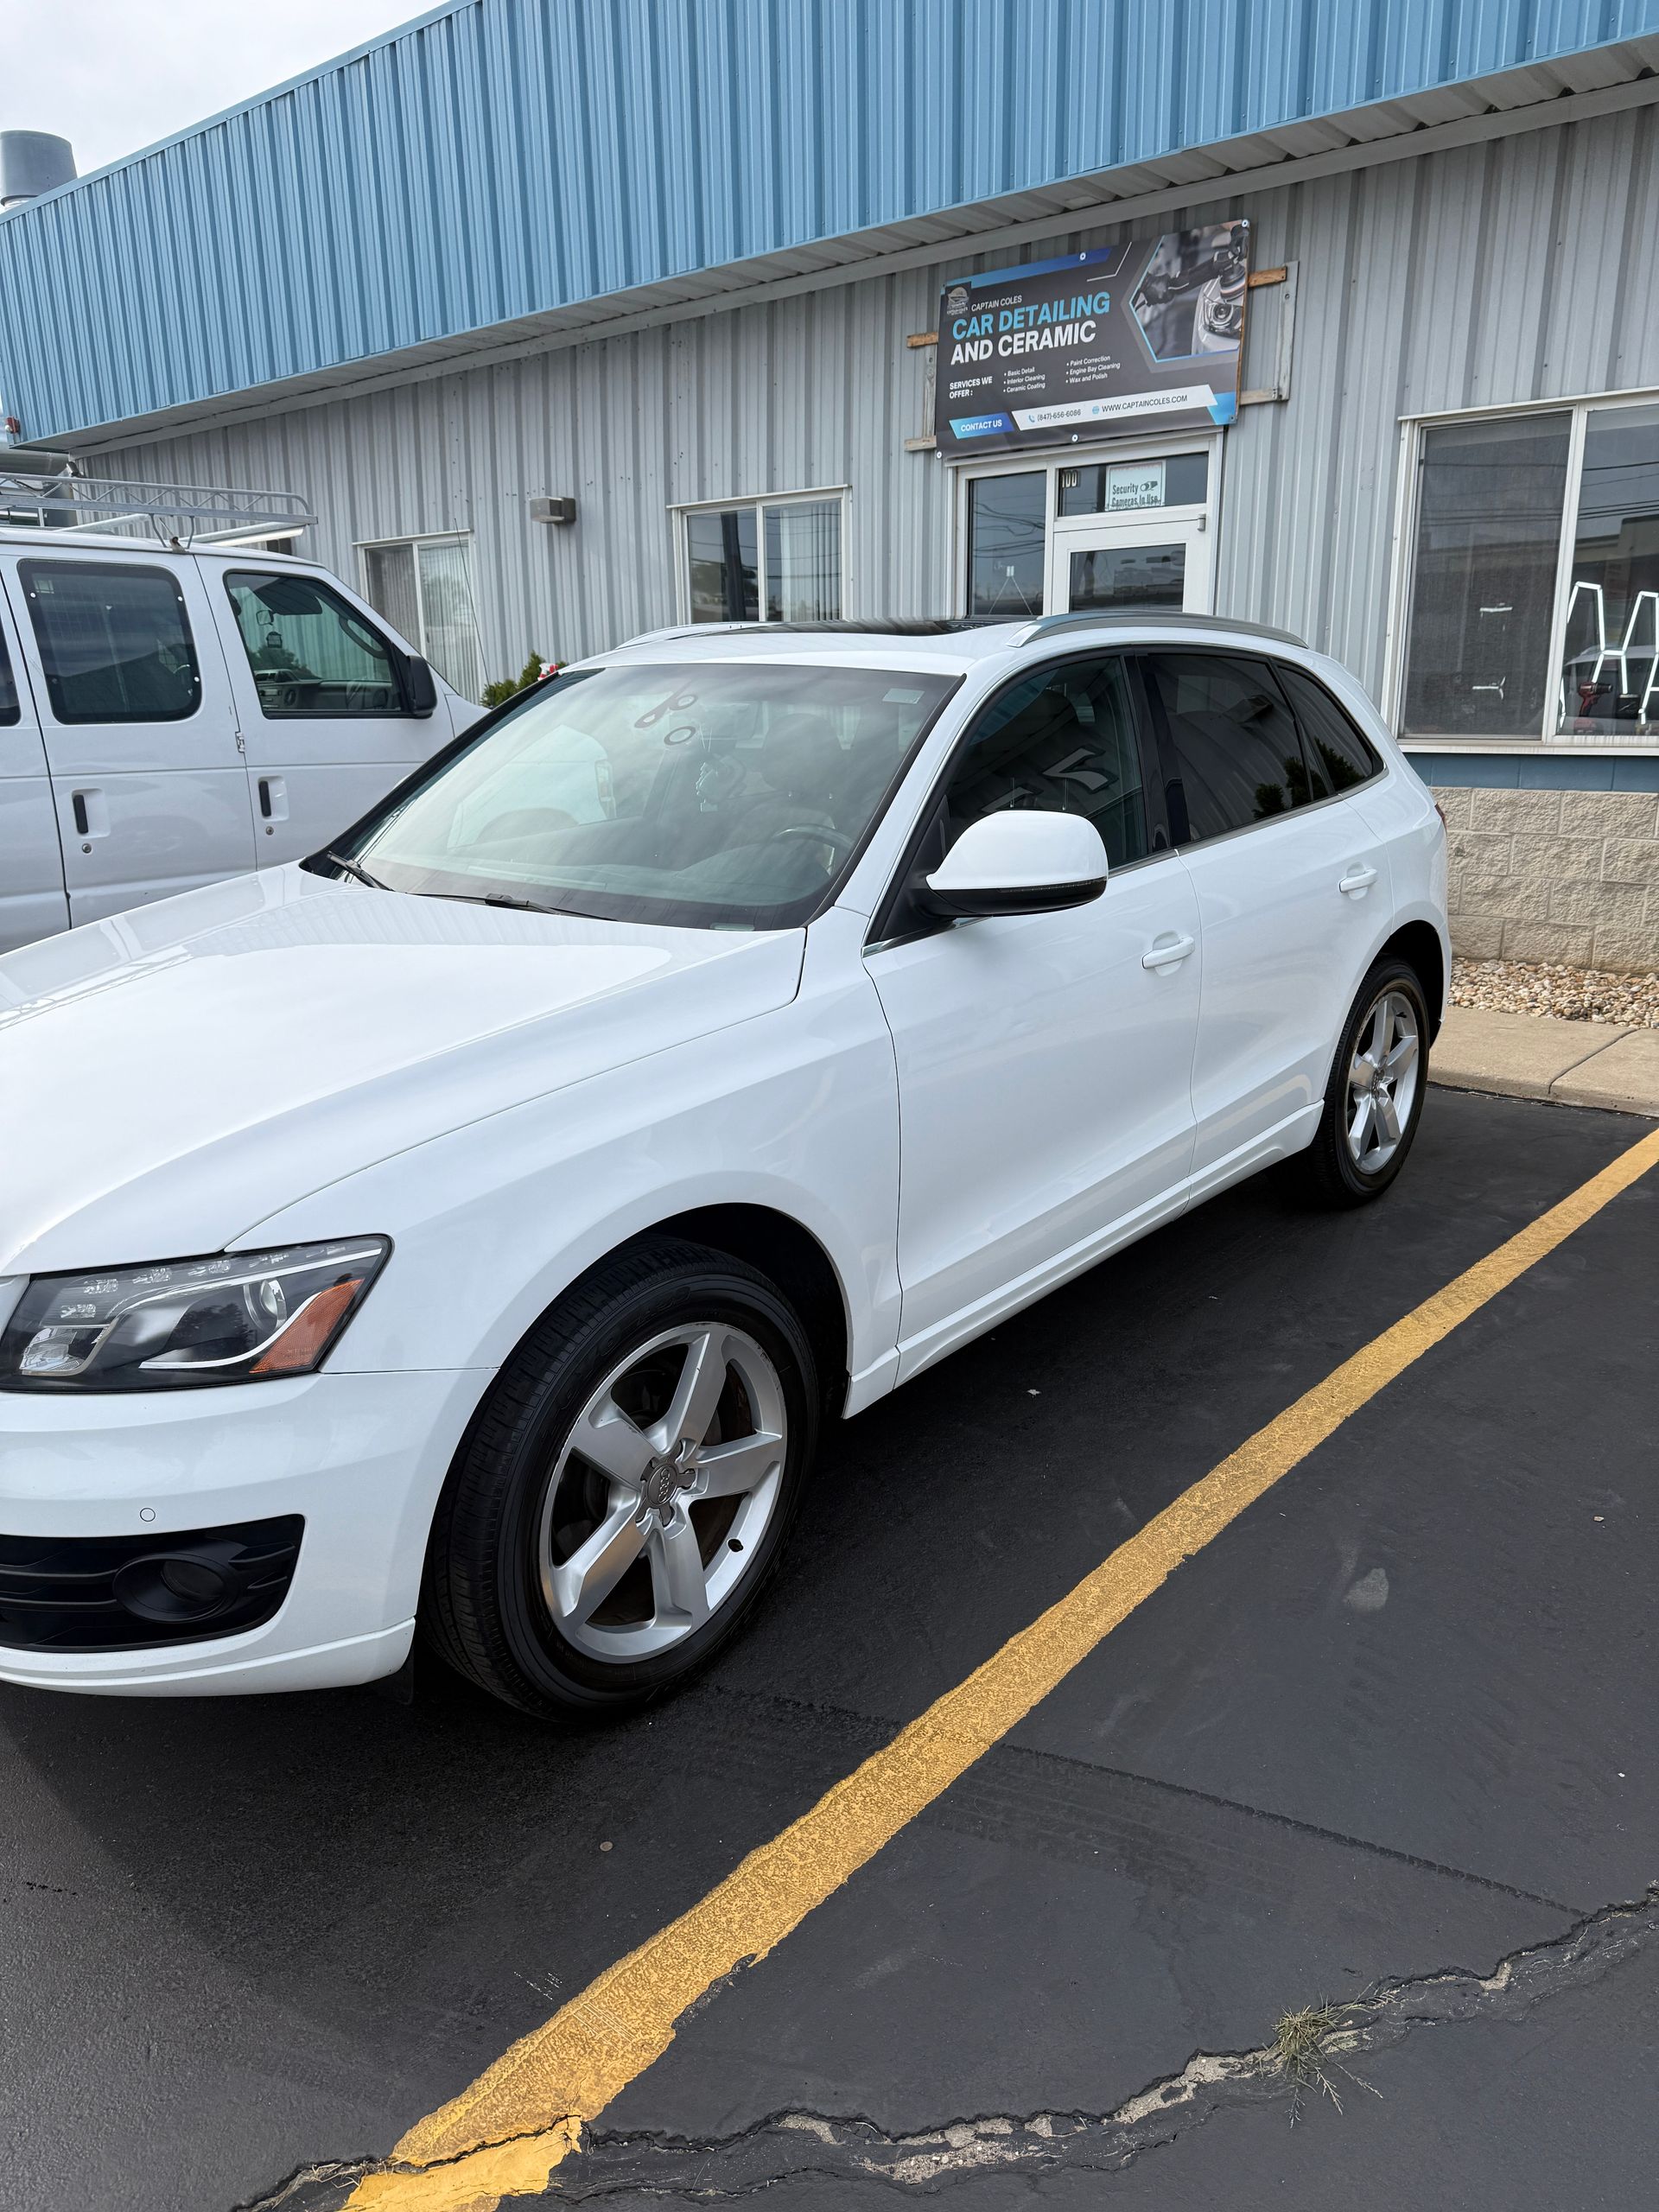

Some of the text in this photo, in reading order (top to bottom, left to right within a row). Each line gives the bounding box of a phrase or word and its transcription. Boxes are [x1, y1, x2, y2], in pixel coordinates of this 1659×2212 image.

[971, 299, 1000, 312] CAPTAIN
[1000, 295, 1022, 308] COLES
[952, 315, 993, 340] CAR
[999, 291, 1111, 333] DETAILING
[950, 320, 1096, 365] AND CERAMIC
[1084, 355, 1111, 365] Correction
[1007, 366, 1035, 377] Basic Detail
[1070, 362, 1121, 376] Engine Bay Cleaning
[950, 376, 993, 390] SERVICES WE
[1007, 373, 1046, 385] Interior Cleaning
[1092, 372, 1108, 381] Polish
[1006, 382, 1046, 393] Ceramic Coating
[1102, 395, 1187, 412] WWW.CAPTAINCOLES.COM
[961, 419, 1002, 432] CONTACT US
[1112, 482, 1139, 496] Security
[1111, 496, 1139, 508] Cameras
[1139, 494, 1146, 505] In
